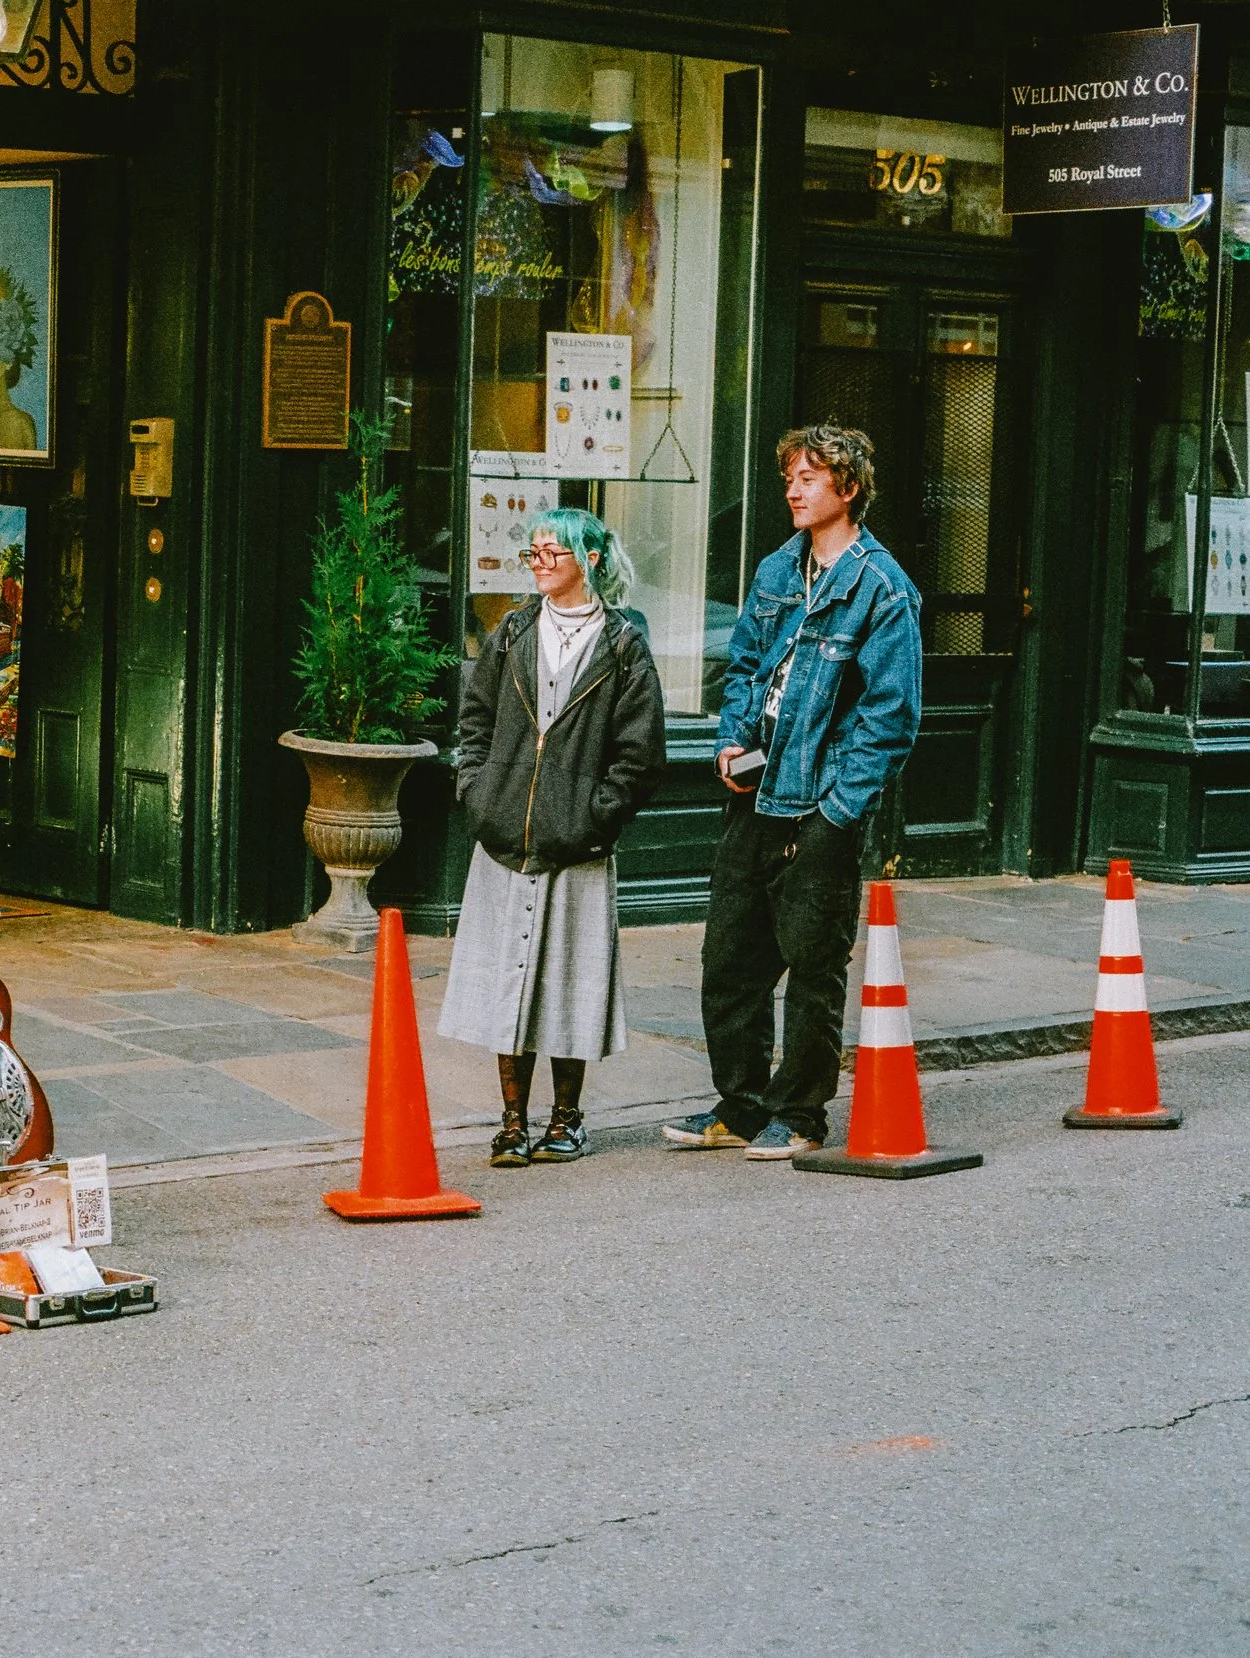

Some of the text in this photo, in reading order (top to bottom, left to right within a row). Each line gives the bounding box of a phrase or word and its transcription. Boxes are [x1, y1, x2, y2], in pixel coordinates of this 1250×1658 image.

[1011, 79, 1128, 105] WELLINGTON
[1133, 75, 1150, 96] &
[1011, 112, 1186, 137] Fine Jewelry Antique & Estate Jewelry
[870, 148, 946, 195] 505
[1048, 164, 1142, 184] 505 Royal Street
[399, 240, 421, 270] les
[551, 337, 604, 348] WELLINGTON
[14, 1203, 30, 1212] TIP
[33, 1198, 52, 1208] JAR
[79, 1228, 105, 1240] venmo
